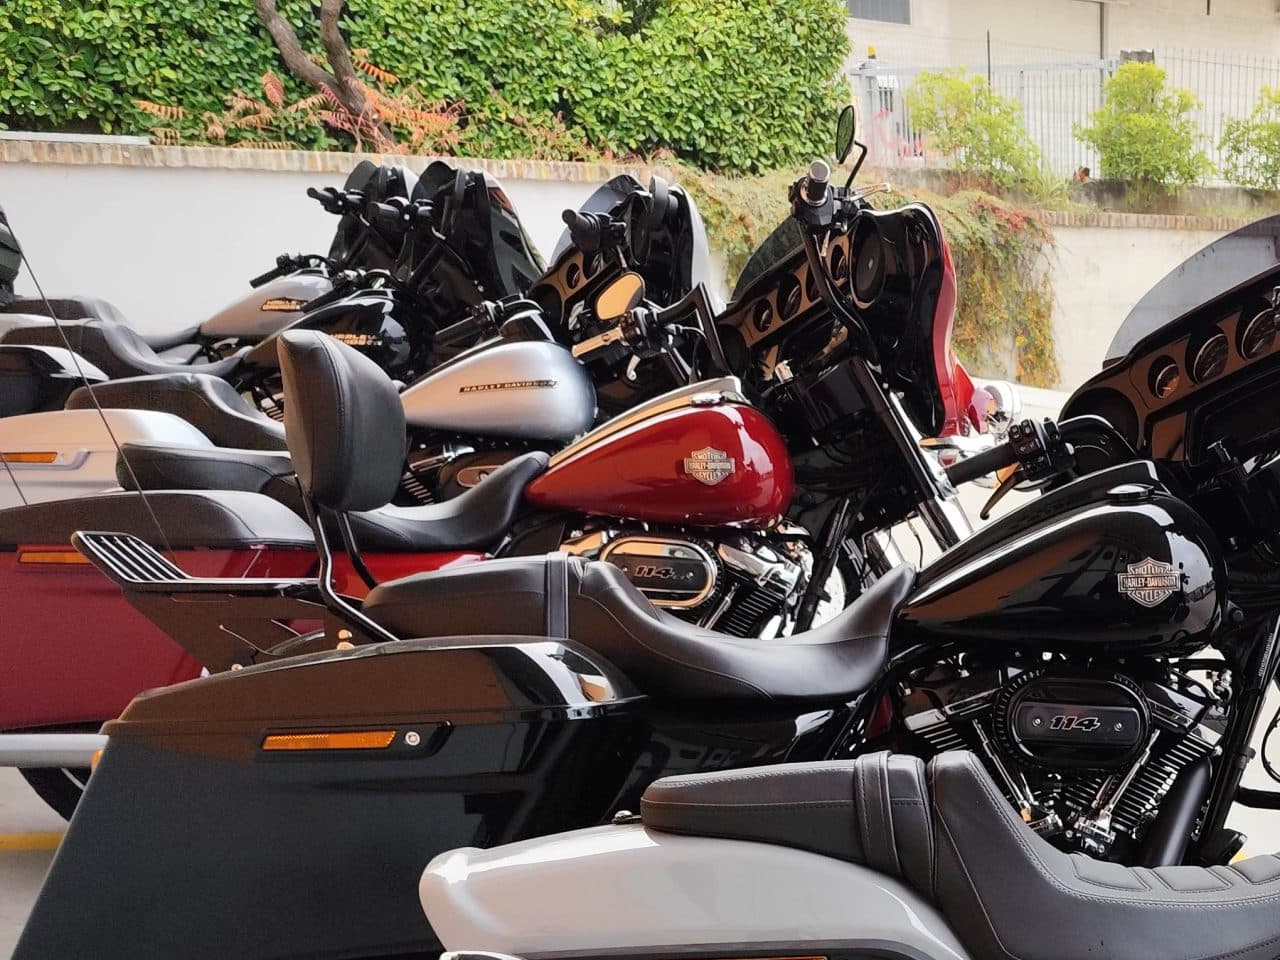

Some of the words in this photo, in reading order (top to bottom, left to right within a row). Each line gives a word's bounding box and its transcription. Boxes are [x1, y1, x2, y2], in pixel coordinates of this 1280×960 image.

[634, 565, 674, 579] 114
[1135, 564, 1164, 575] MOTOR
[1123, 576, 1176, 588] HARLEY-DAVIDSON
[1050, 715, 1101, 732] 114
